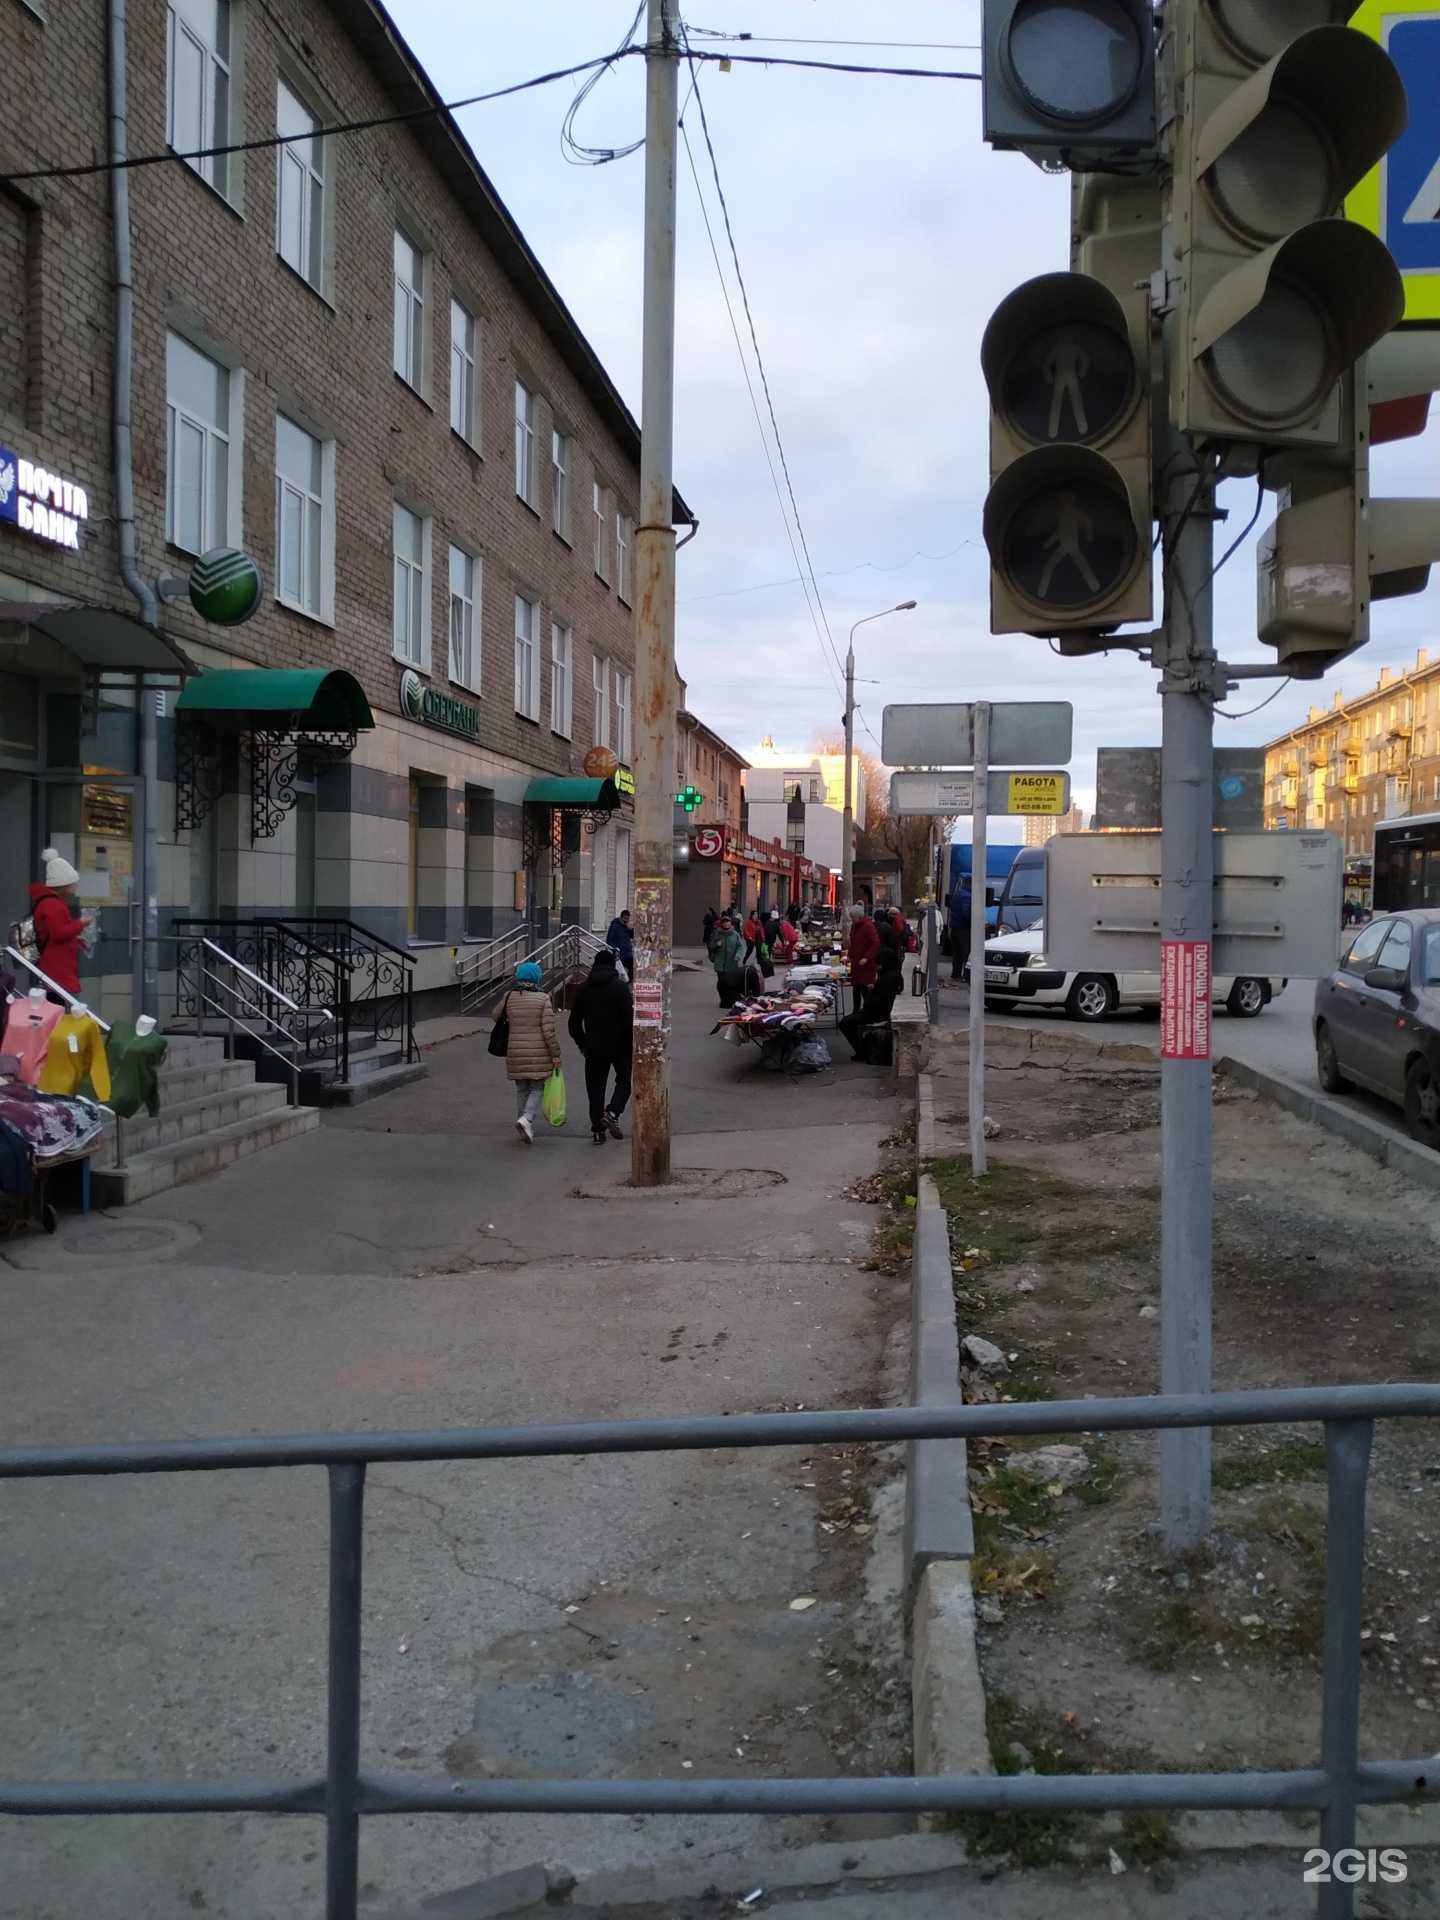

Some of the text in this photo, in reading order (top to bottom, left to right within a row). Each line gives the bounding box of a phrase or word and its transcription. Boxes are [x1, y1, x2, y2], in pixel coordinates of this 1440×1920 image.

[1014, 777, 1057, 787] РАБОТА
[1196, 944, 1208, 997] ПОМОЩЬ
[1166, 946, 1176, 1053] ЕЖЕДНЕВНЫЕ ВЫПЛАТЫ
